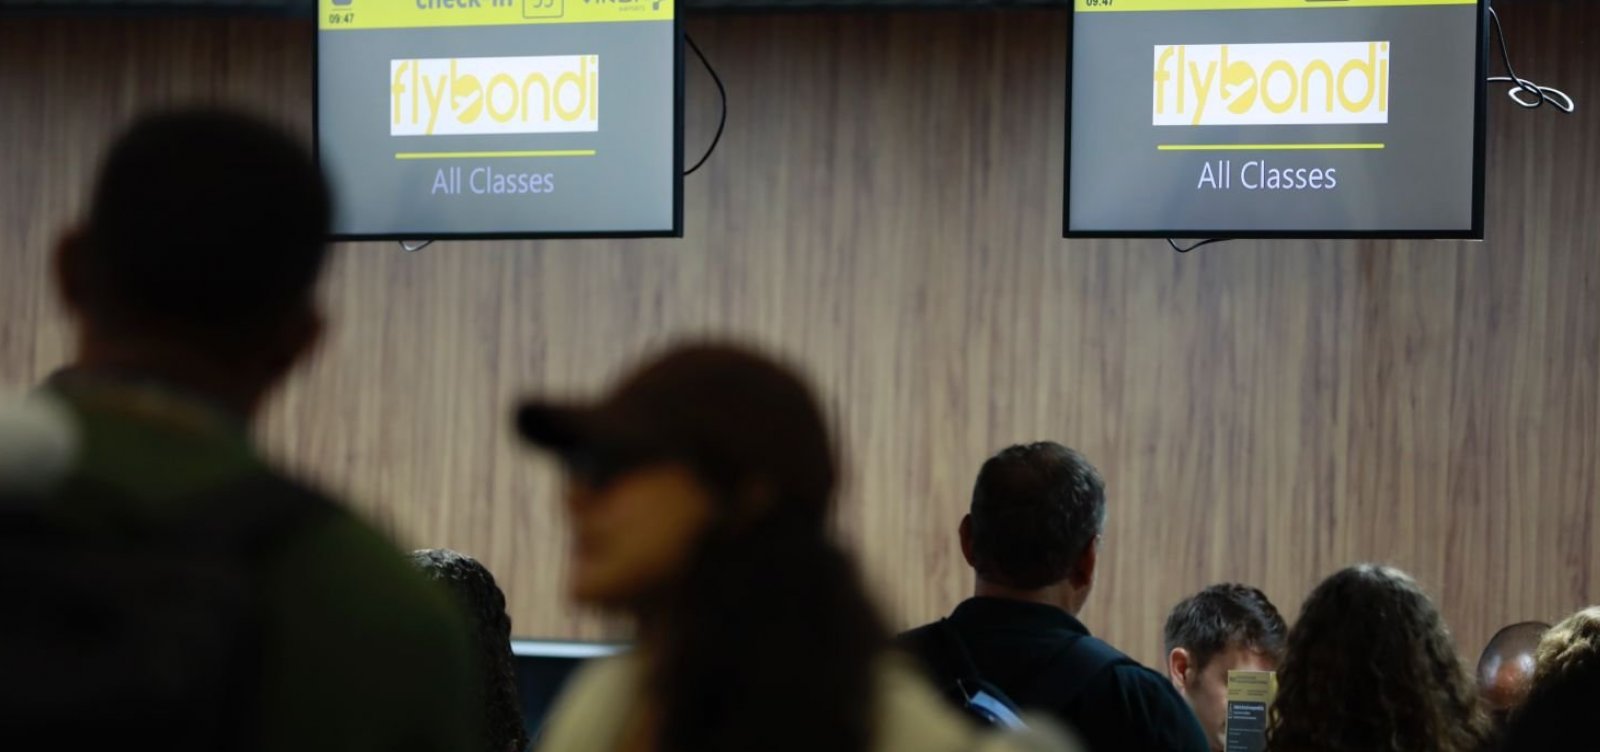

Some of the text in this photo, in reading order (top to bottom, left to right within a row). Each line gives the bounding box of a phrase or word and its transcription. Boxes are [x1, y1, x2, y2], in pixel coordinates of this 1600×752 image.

[328, 13, 355, 25] 09:47
[416, 0, 514, 9] checkin
[392, 56, 597, 135] flybondi
[1154, 41, 1387, 125] flybondi
[431, 166, 554, 194] All Classes
[1197, 160, 1337, 190] All Classes
